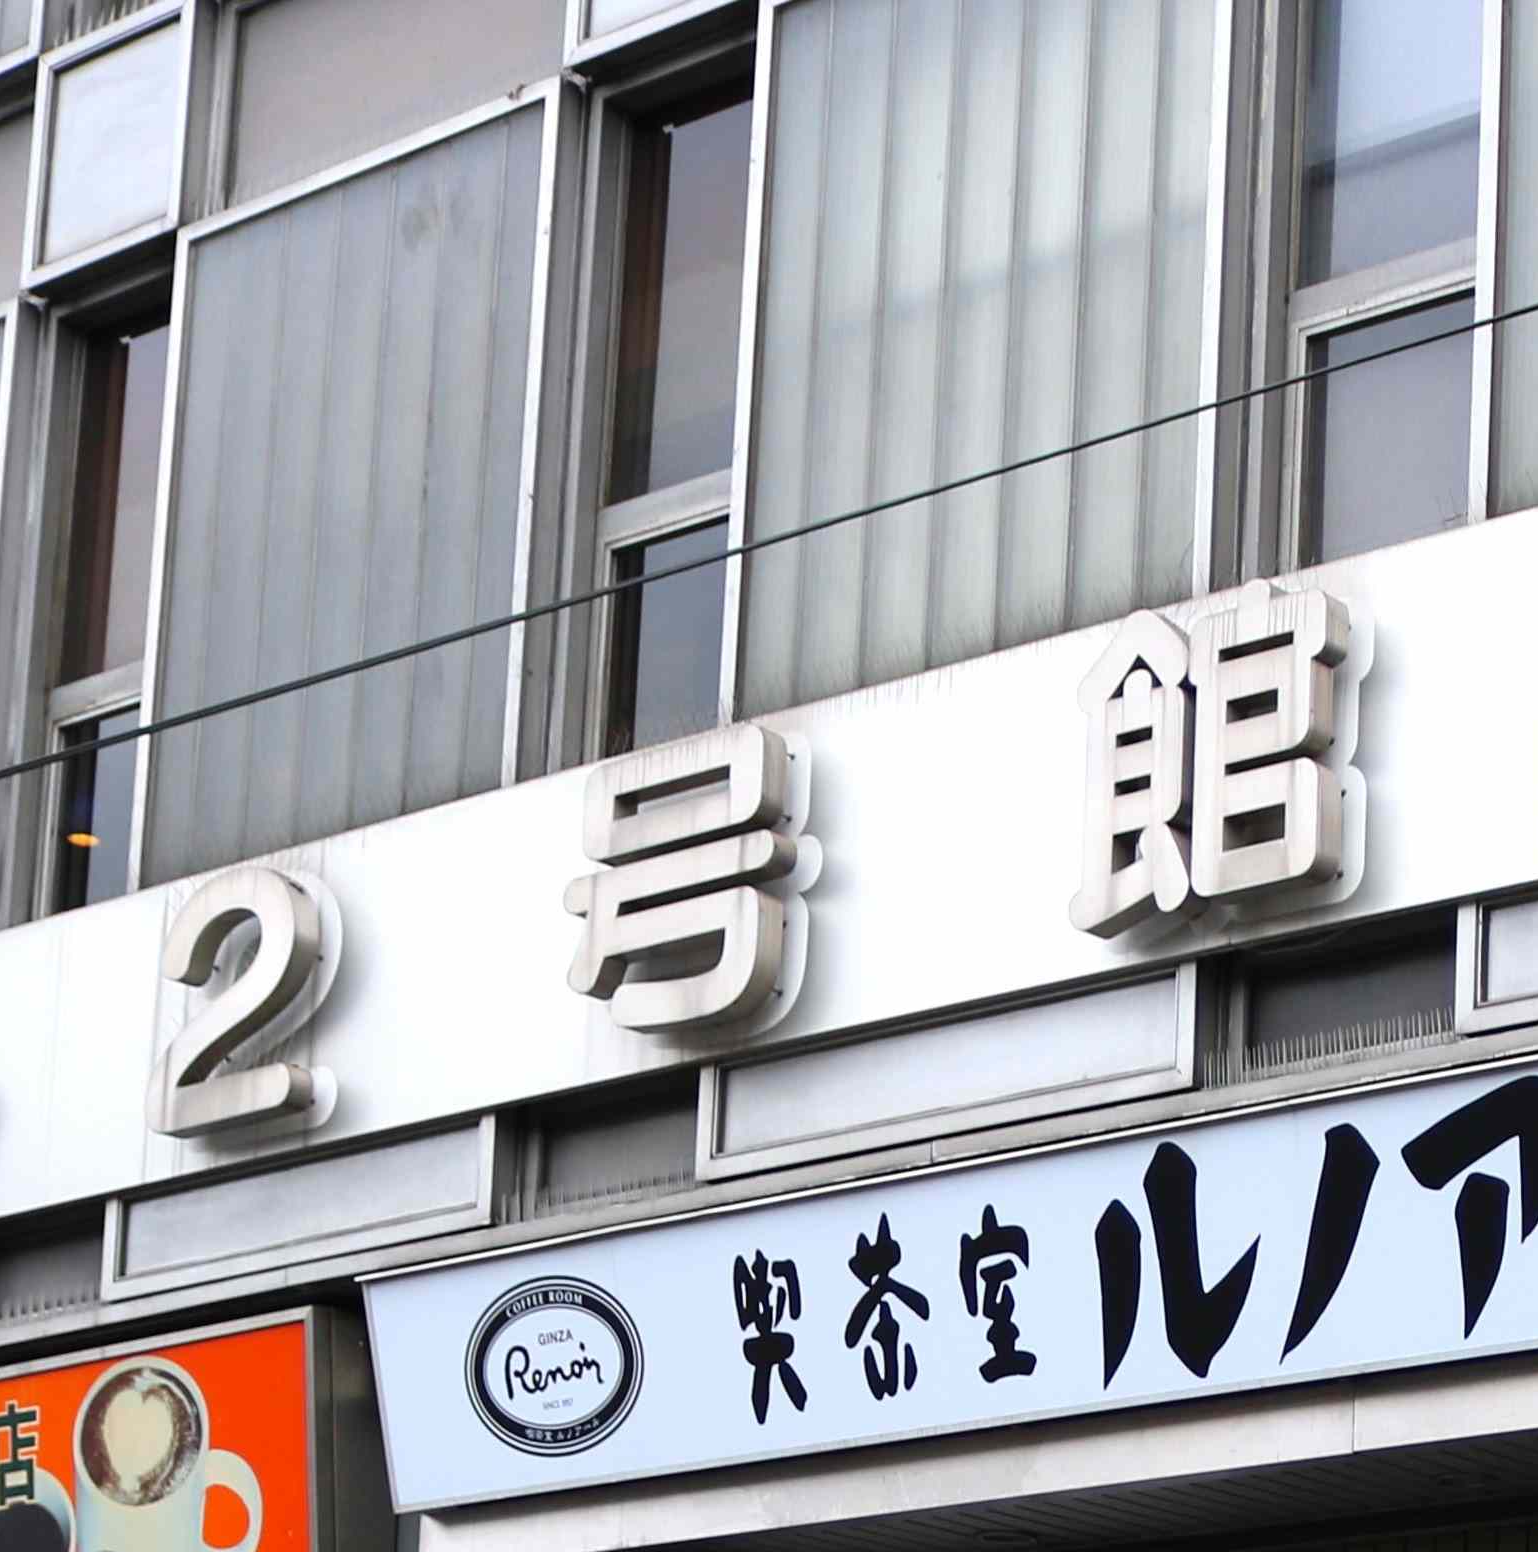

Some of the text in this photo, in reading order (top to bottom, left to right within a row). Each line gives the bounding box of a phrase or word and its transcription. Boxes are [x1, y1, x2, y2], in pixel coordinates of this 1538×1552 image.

[505, 1290, 583, 1318] COFFEE ROOM
[537, 1328, 574, 1346] GINZA
[504, 1341, 604, 1401] Renoir
